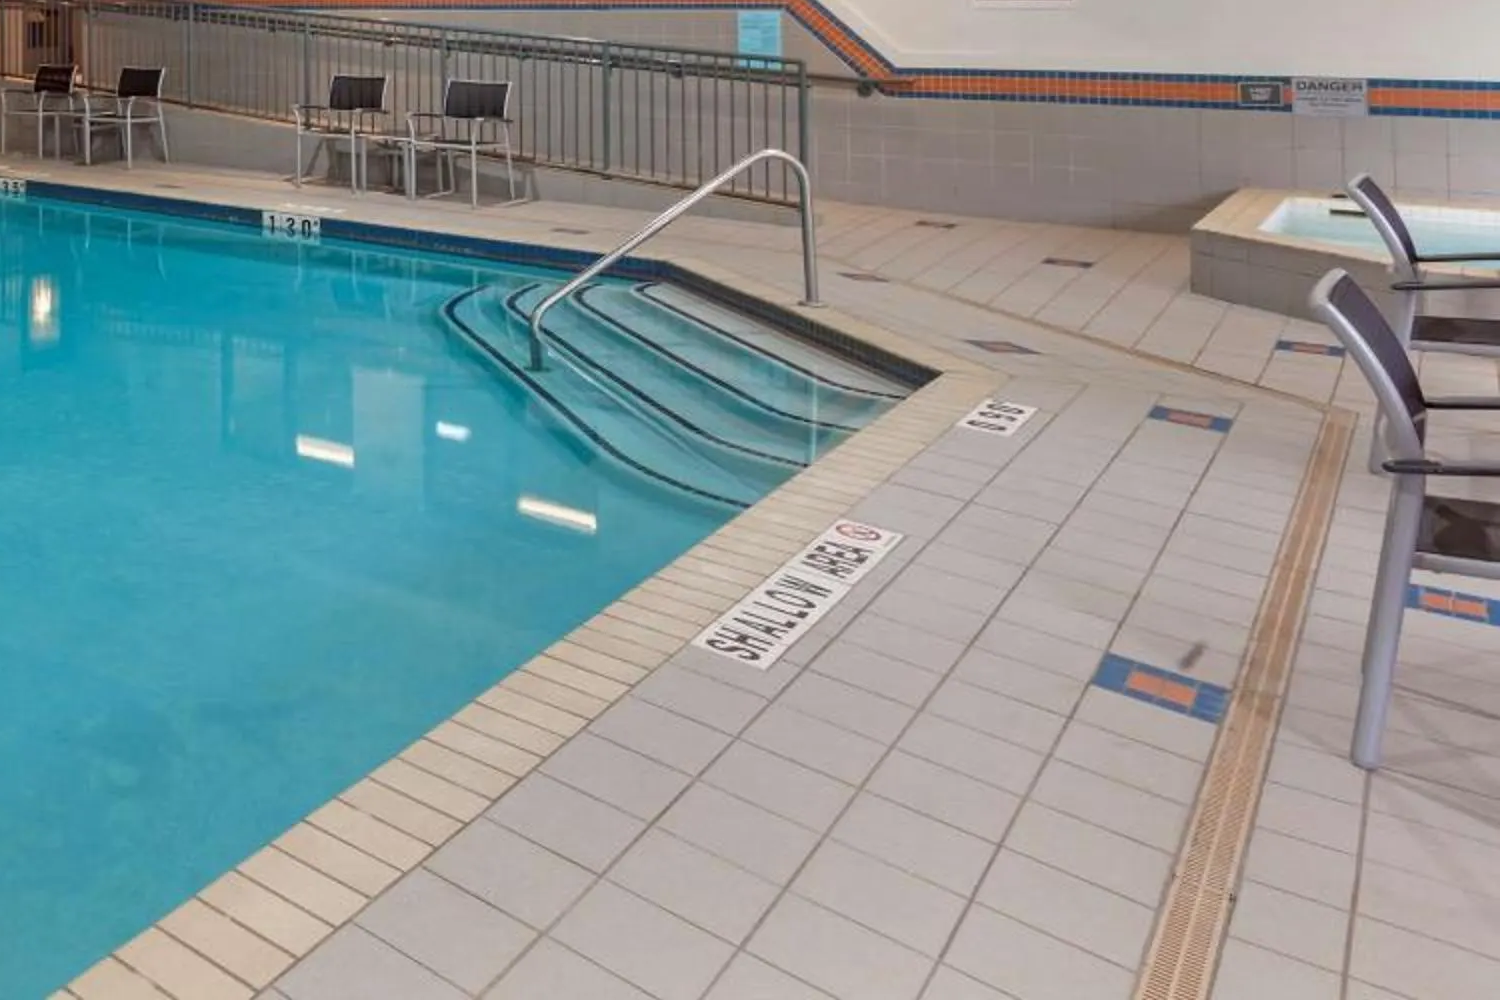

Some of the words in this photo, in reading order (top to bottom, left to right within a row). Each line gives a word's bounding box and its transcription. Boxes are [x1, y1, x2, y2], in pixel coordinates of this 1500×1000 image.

[1296, 81, 1363, 92] DANGER
[706, 574, 833, 661] SHALLOW
[801, 541, 874, 579] AREA
